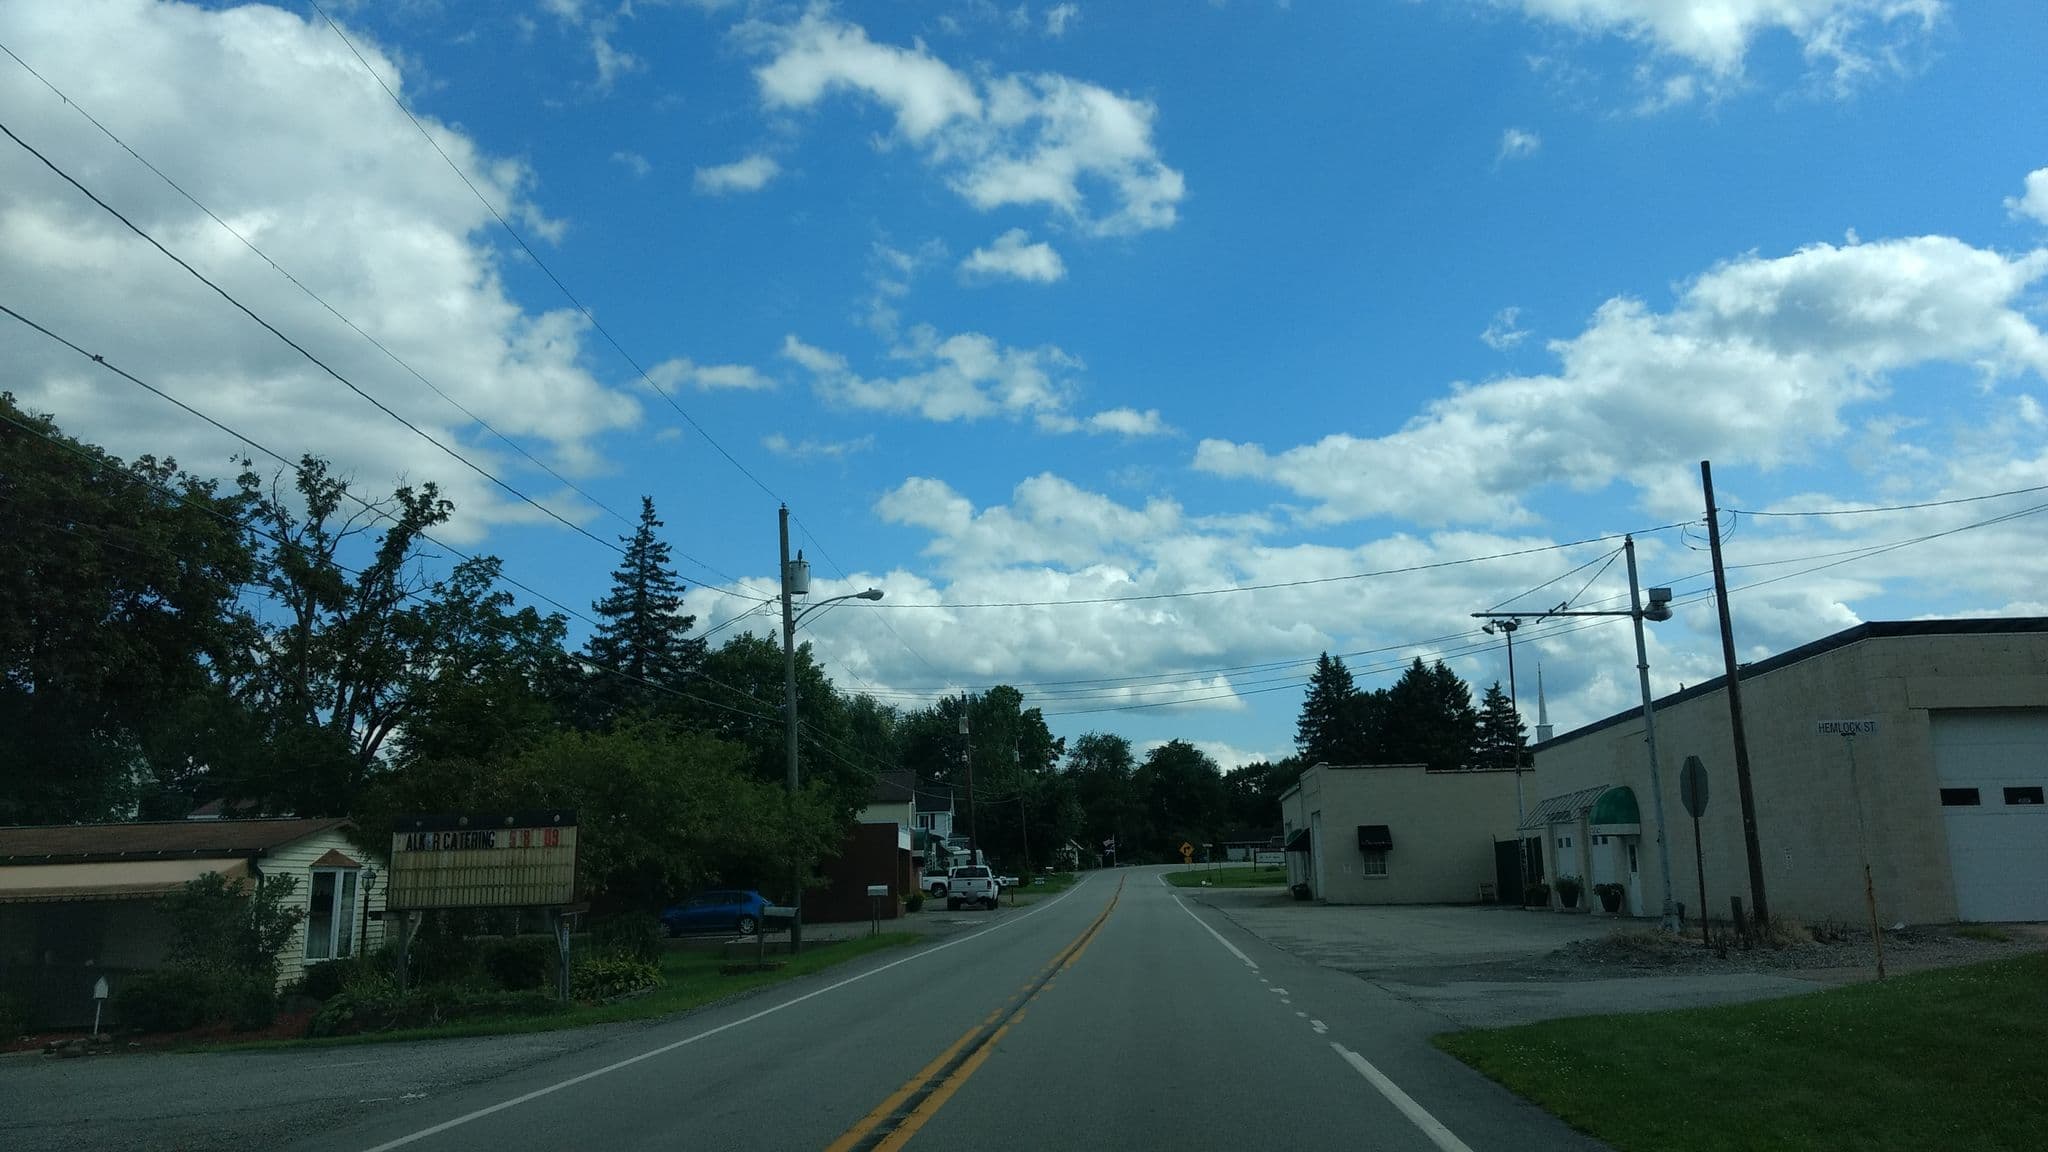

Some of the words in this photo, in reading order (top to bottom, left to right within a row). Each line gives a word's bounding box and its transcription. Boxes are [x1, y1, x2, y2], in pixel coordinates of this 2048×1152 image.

[1818, 721, 1862, 733] HEMLOCK
[1864, 721, 1875, 733] ST
[406, 831, 441, 850] ALKR
[443, 830, 495, 849] CATERING
